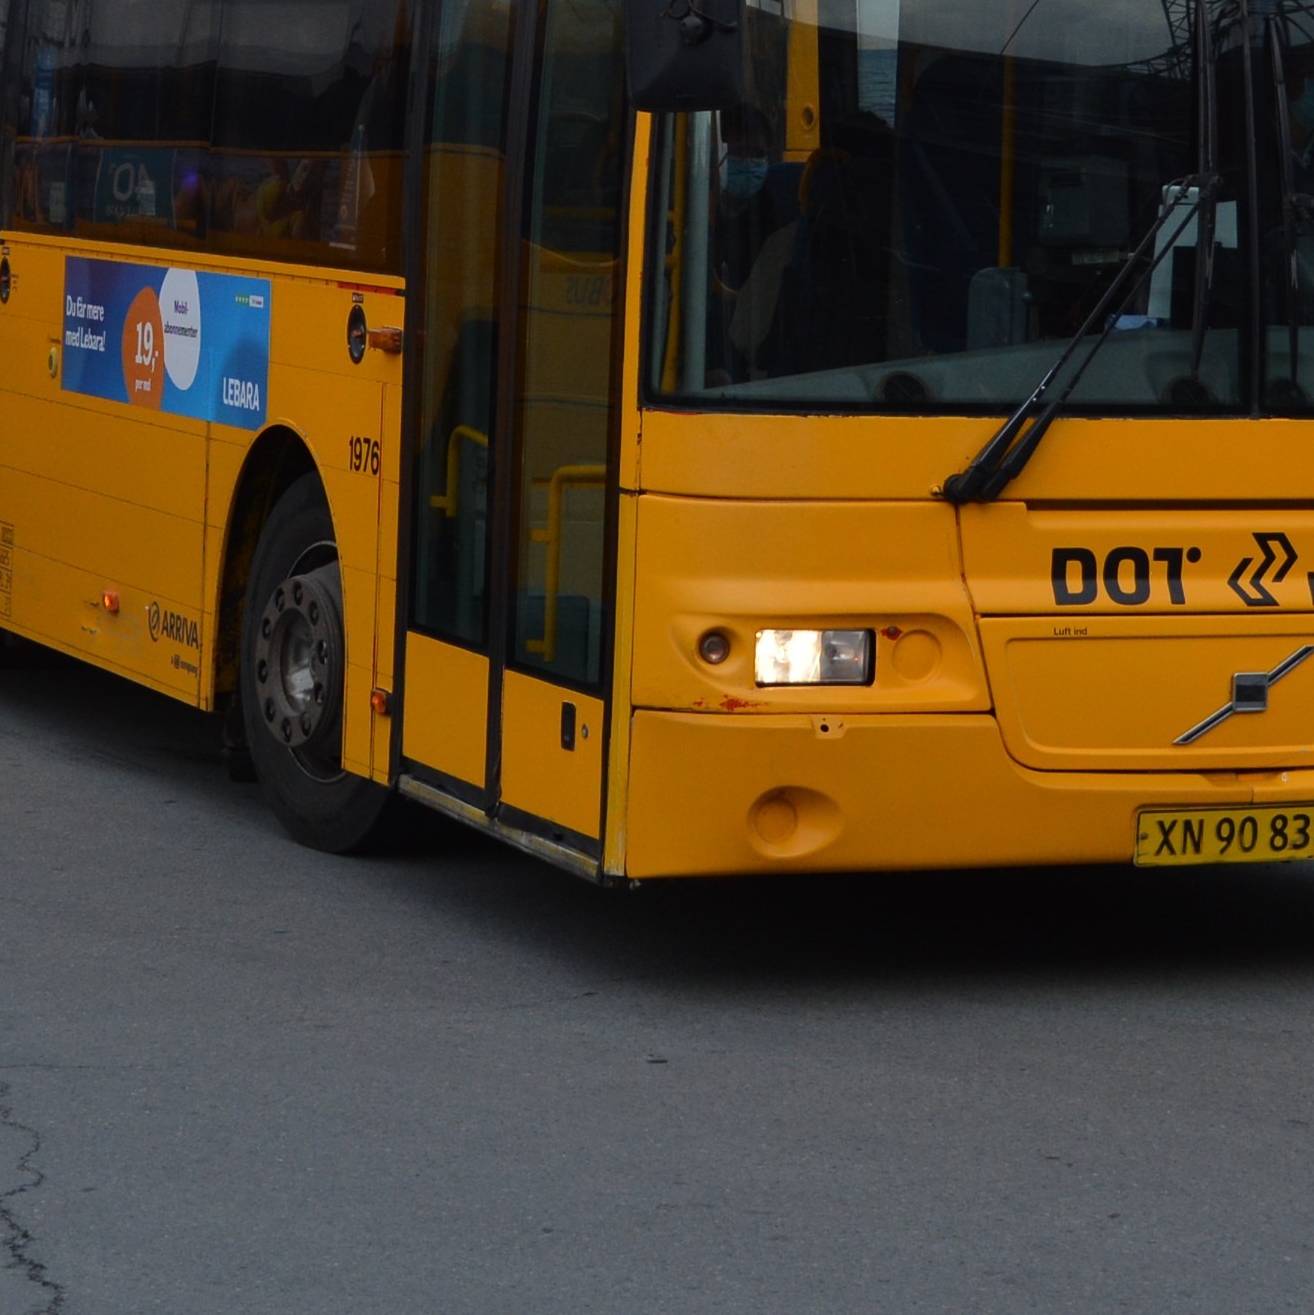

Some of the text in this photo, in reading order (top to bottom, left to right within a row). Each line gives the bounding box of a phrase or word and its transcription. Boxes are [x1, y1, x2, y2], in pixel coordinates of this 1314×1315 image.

[66, 295, 76, 317] Du
[86, 302, 104, 322] mere
[174, 300, 188, 314] Mobil-
[65, 327, 106, 352] med Lebara!
[164, 321, 198, 338] abonnementer
[223, 377, 260, 412] LEBARA
[348, 435, 380, 476] 1976
[1049, 544, 1203, 606] DOT
[161, 609, 199, 650] ARRIVA
[1052, 626, 1089, 637] Luft ind
[1153, 815, 1206, 858] XN
[1214, 813, 1259, 856] 90
